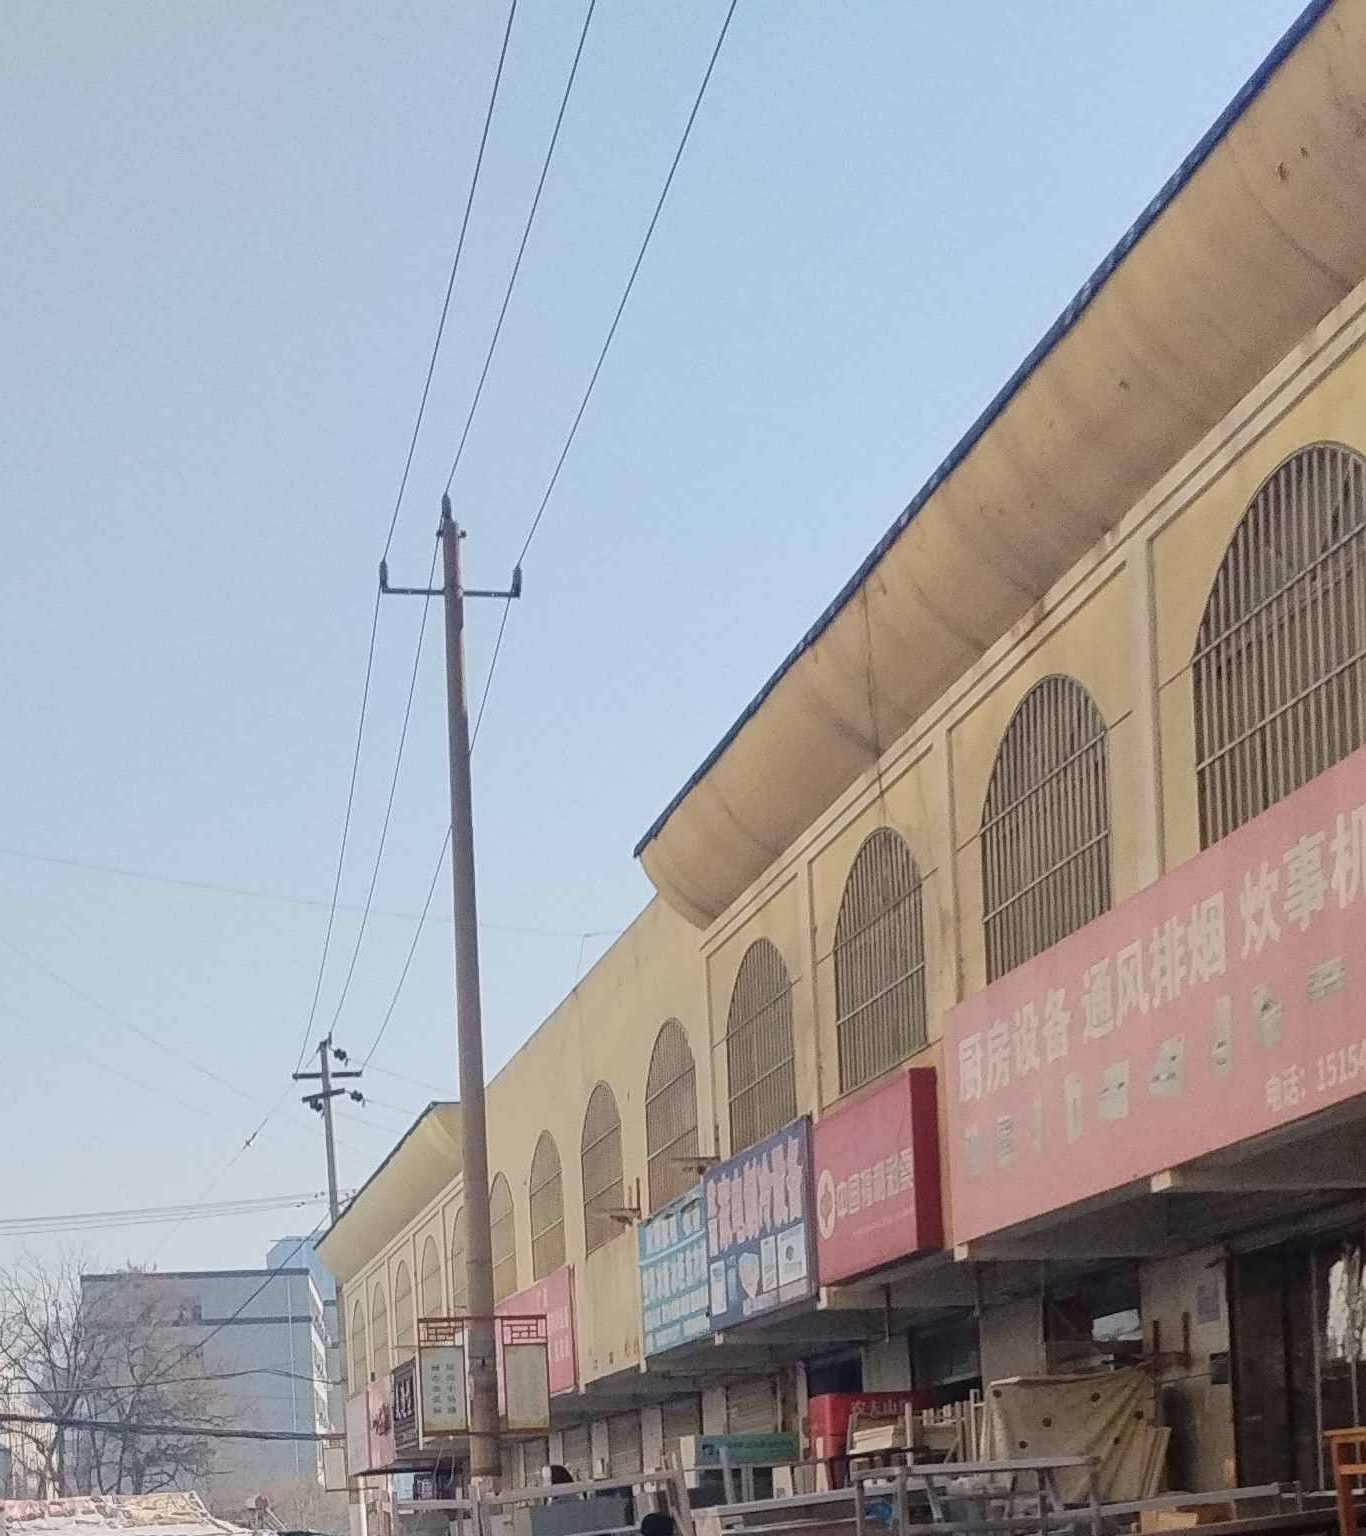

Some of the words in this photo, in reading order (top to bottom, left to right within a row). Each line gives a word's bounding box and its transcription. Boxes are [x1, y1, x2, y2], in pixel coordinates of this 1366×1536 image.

[958, 989, 1072, 1102] 厨房设备
[1082, 891, 1227, 1041] 通风排烟
